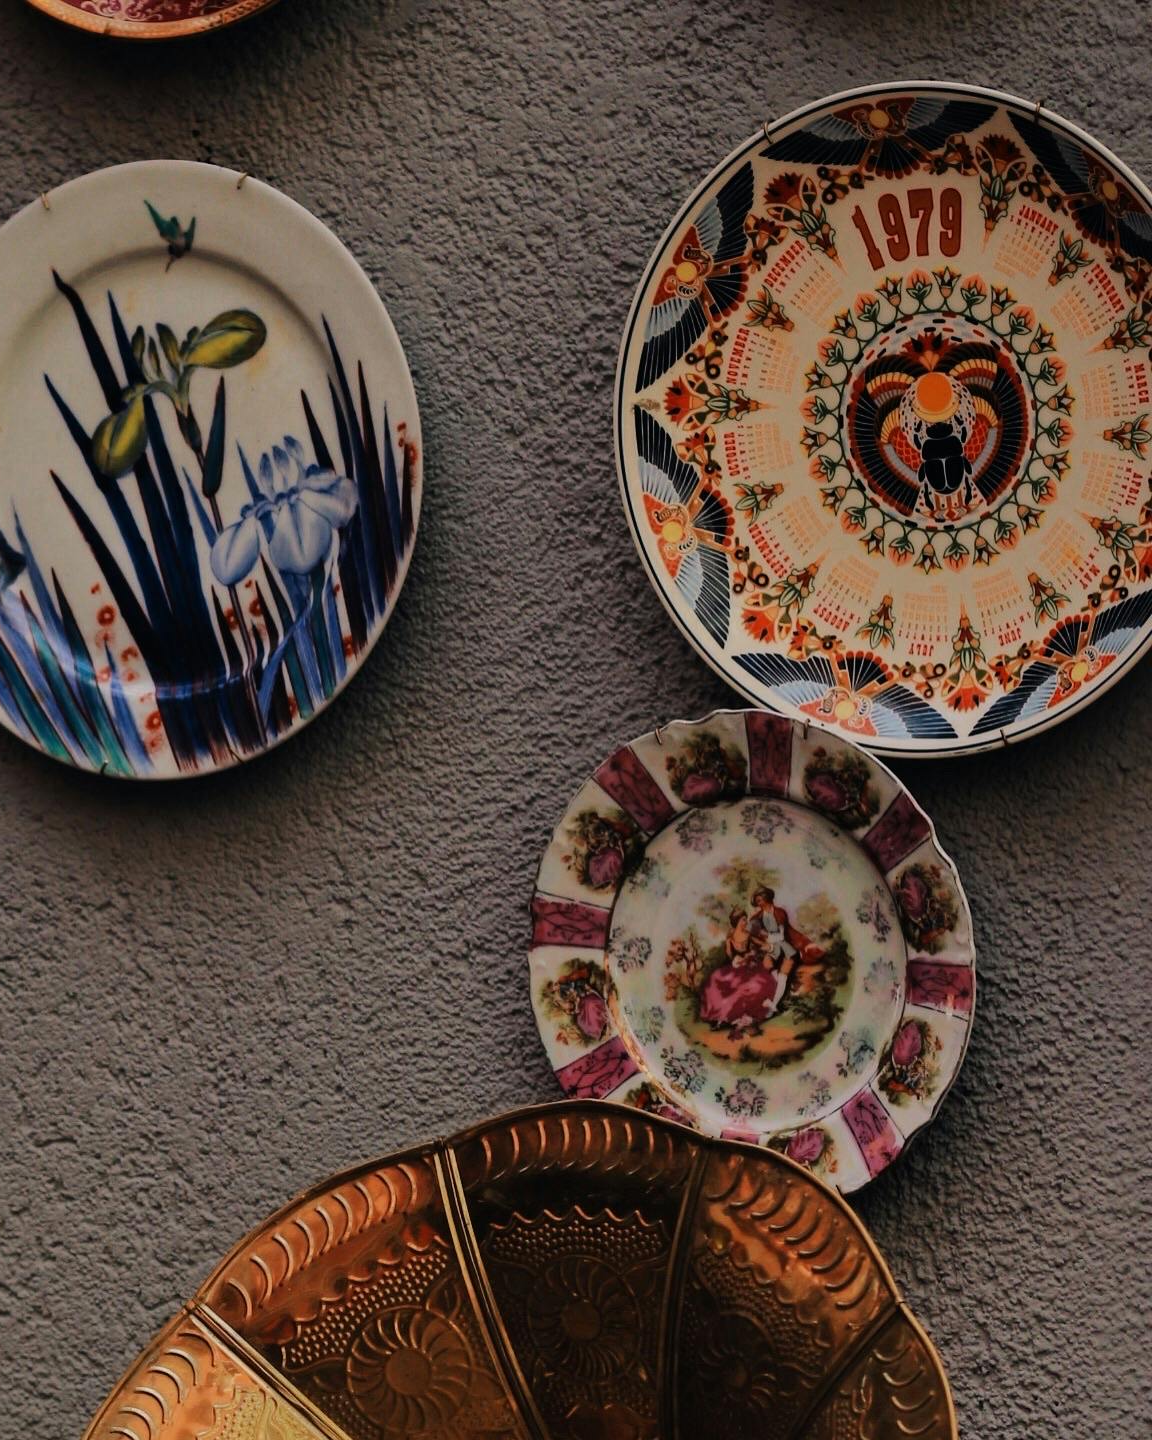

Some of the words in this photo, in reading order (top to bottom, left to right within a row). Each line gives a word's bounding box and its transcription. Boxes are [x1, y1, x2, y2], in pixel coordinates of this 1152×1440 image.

[851, 187, 962, 272] 1979
[1019, 205, 1059, 235] JANUARY
[764, 240, 805, 287] DECEMBER
[1091, 264, 1125, 313] FEBRUARY
[726, 328, 750, 384] NOVEMBER
[1134, 363, 1149, 403] MARCH
[724, 432, 740, 476] OCTOBER
[1125, 472, 1143, 506] APRIL
[749, 524, 787, 578] SEPTEMBER
[1079, 564, 1100, 589] MAY
[813, 604, 849, 632] AUGUST
[998, 628, 1021, 646] JUNE
[908, 643, 934, 657] JULY
